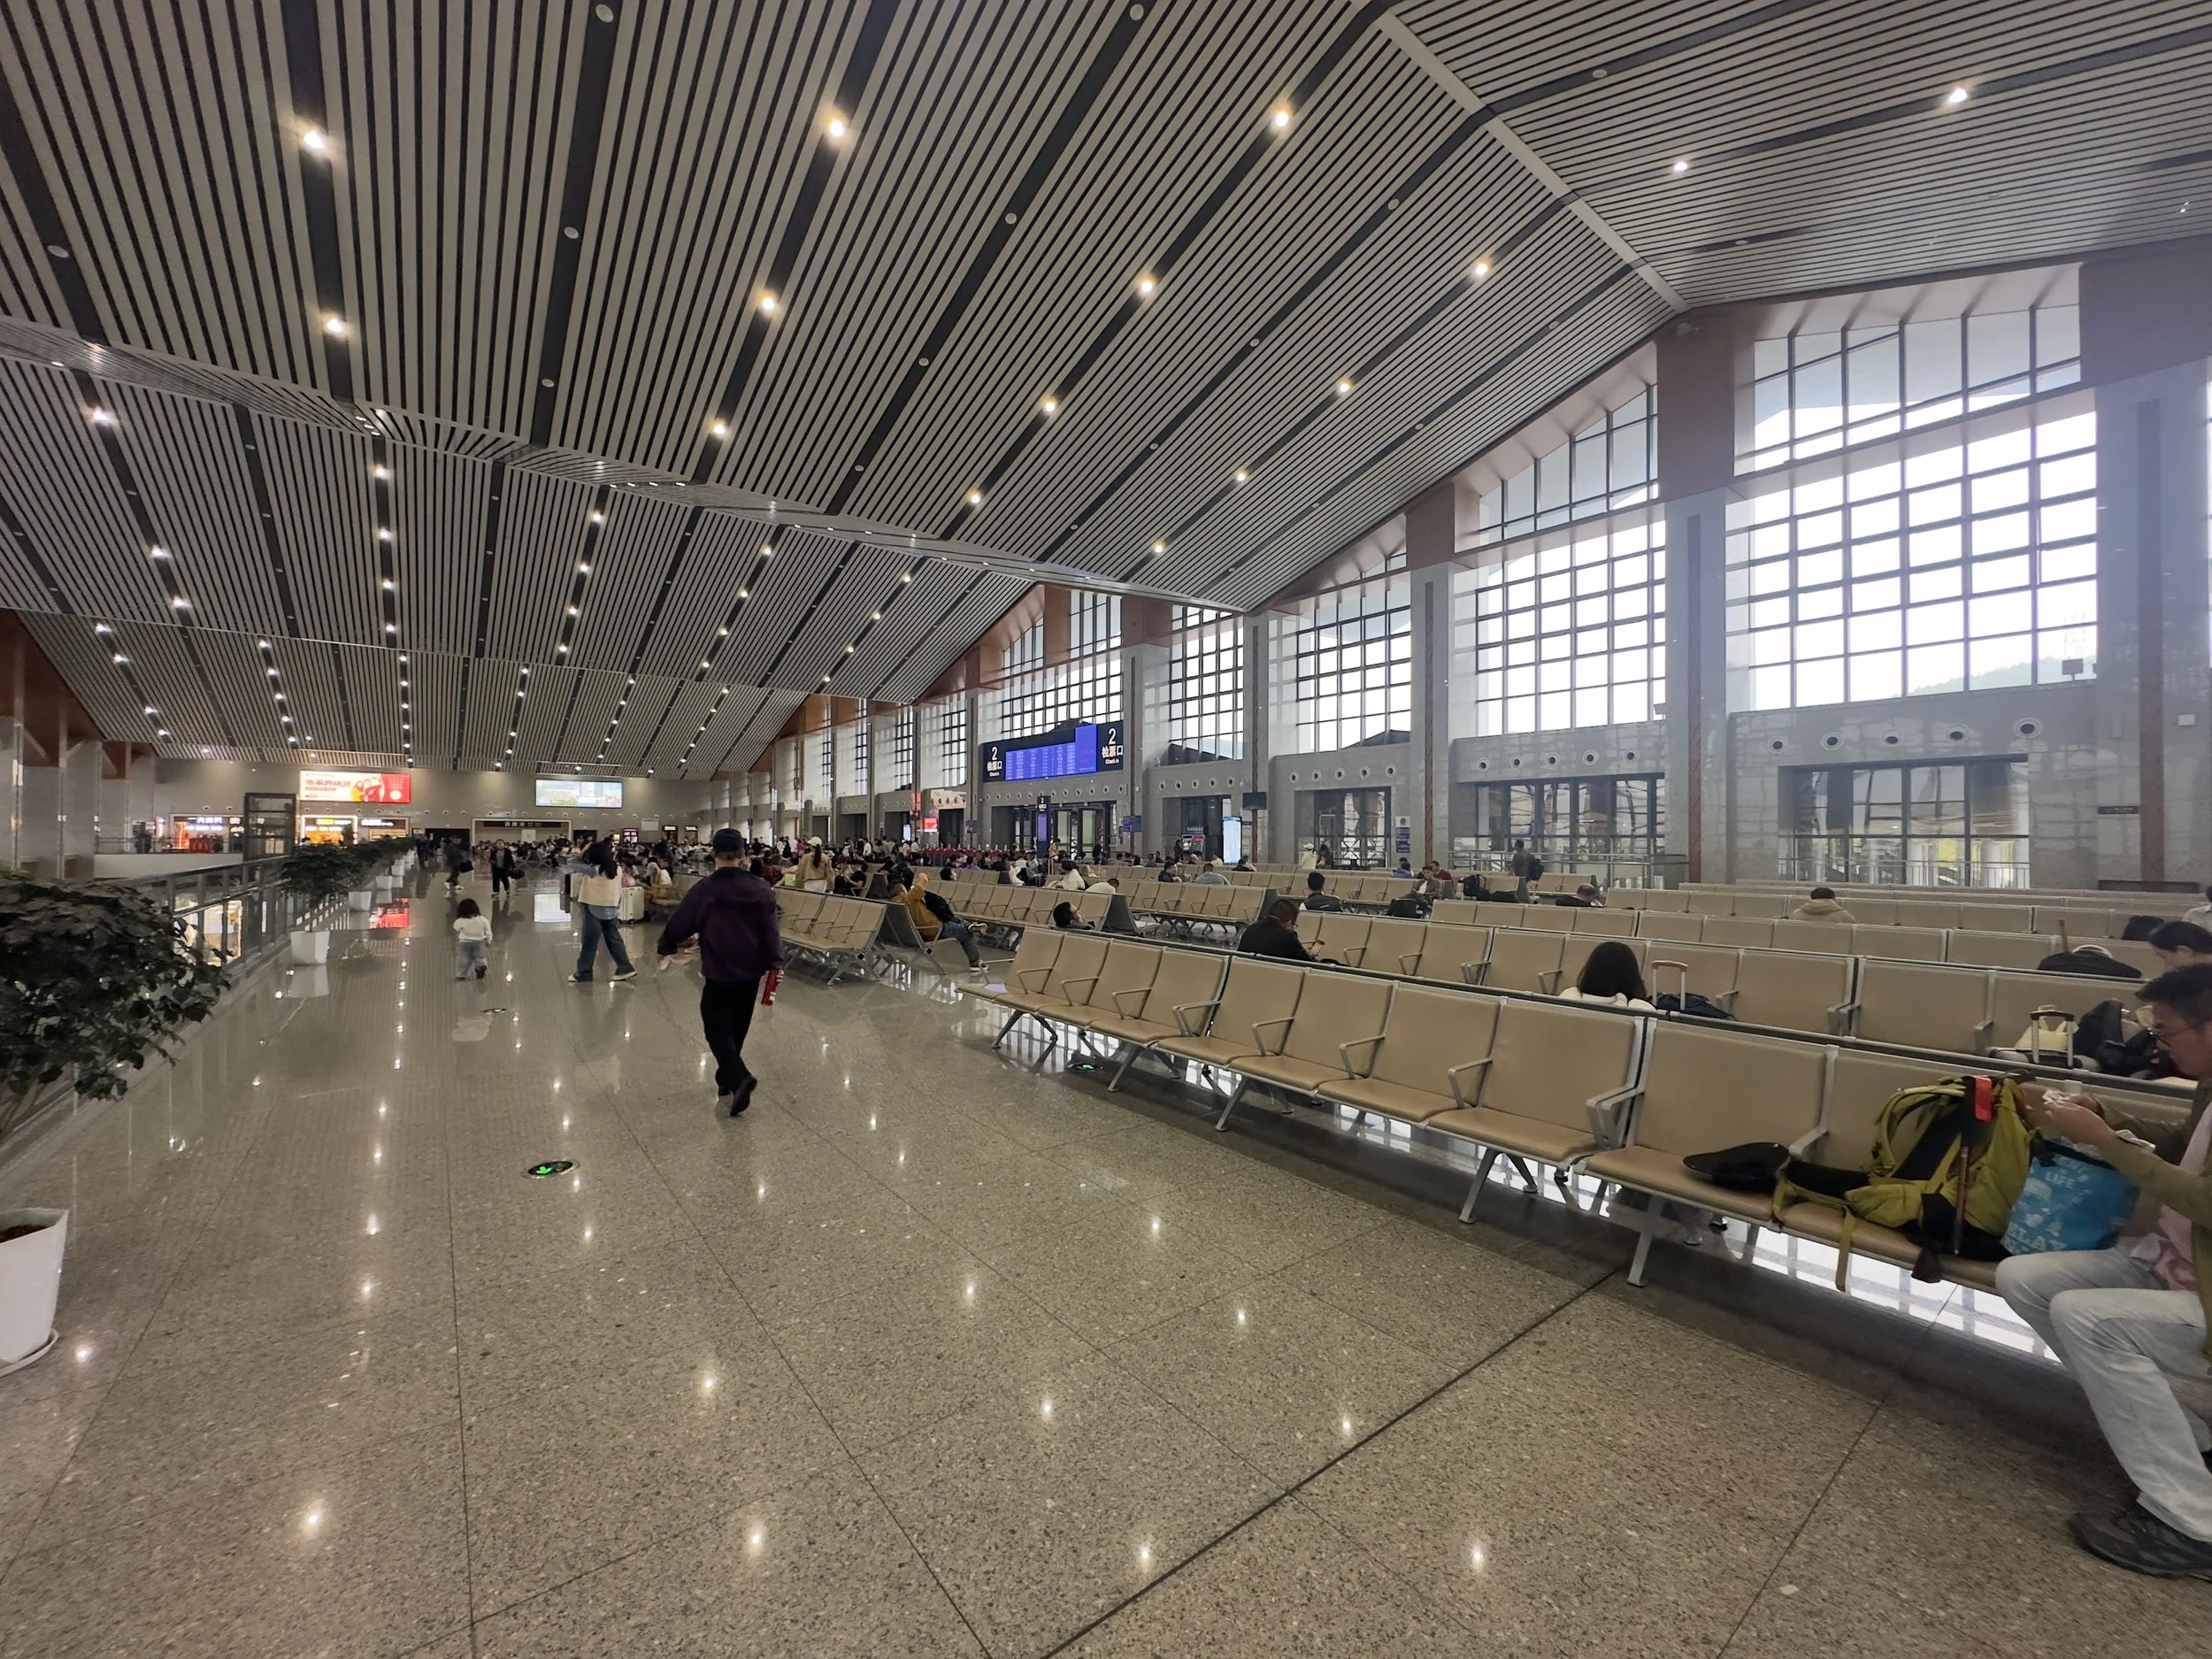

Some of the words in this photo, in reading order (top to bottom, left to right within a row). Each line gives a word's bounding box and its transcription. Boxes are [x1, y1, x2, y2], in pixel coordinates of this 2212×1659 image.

[1108, 727, 1117, 745] 2
[991, 746, 998, 761] 2
[2045, 1171, 2075, 1190] LIFE
